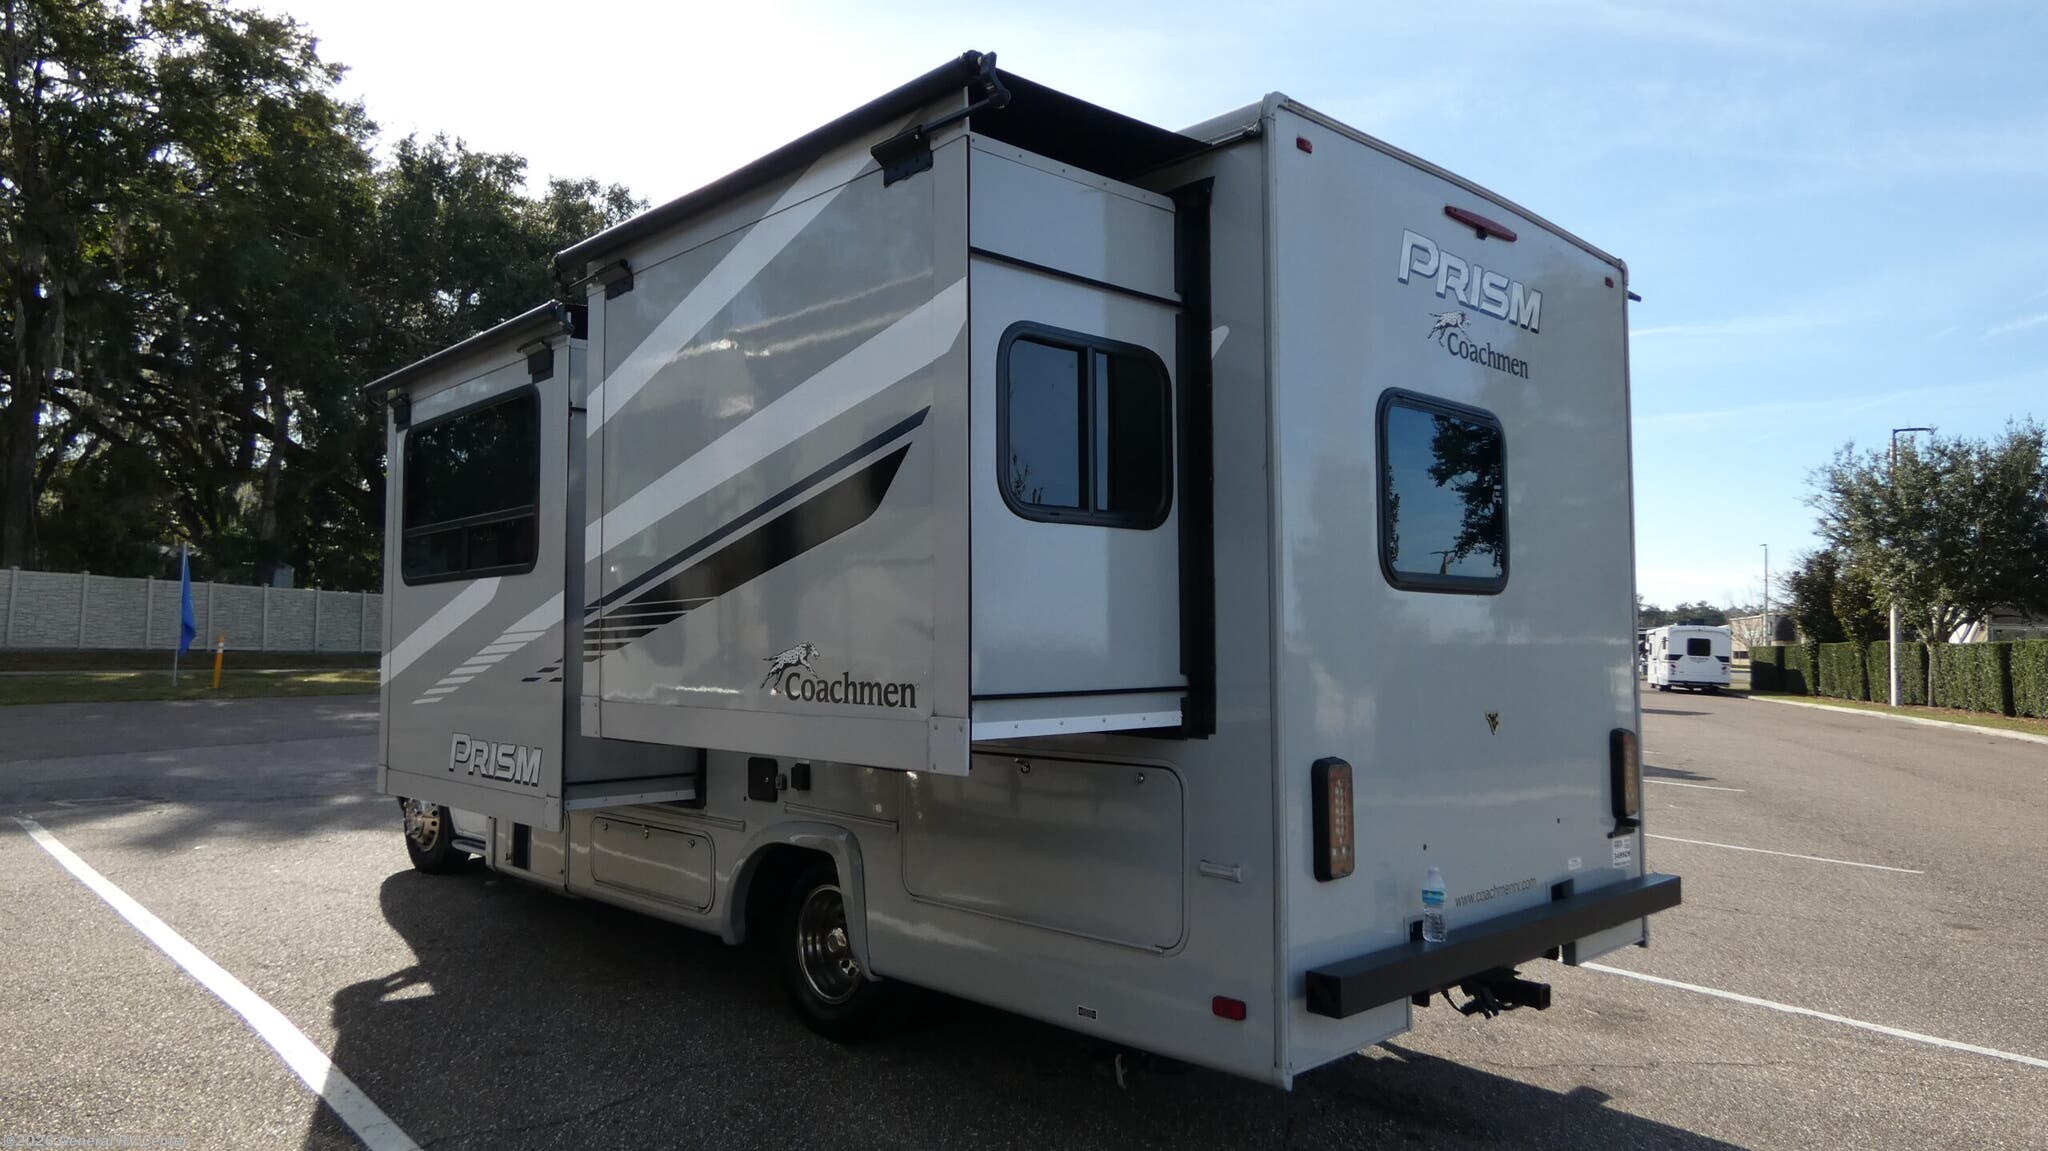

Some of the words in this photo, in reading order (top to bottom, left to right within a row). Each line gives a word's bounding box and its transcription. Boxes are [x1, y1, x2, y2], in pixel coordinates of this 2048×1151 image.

[1398, 228, 1543, 334] PRISM
[1447, 332, 1529, 379] Coachmen
[785, 671, 917, 709] Coachmen
[448, 732, 543, 788] PRISM
